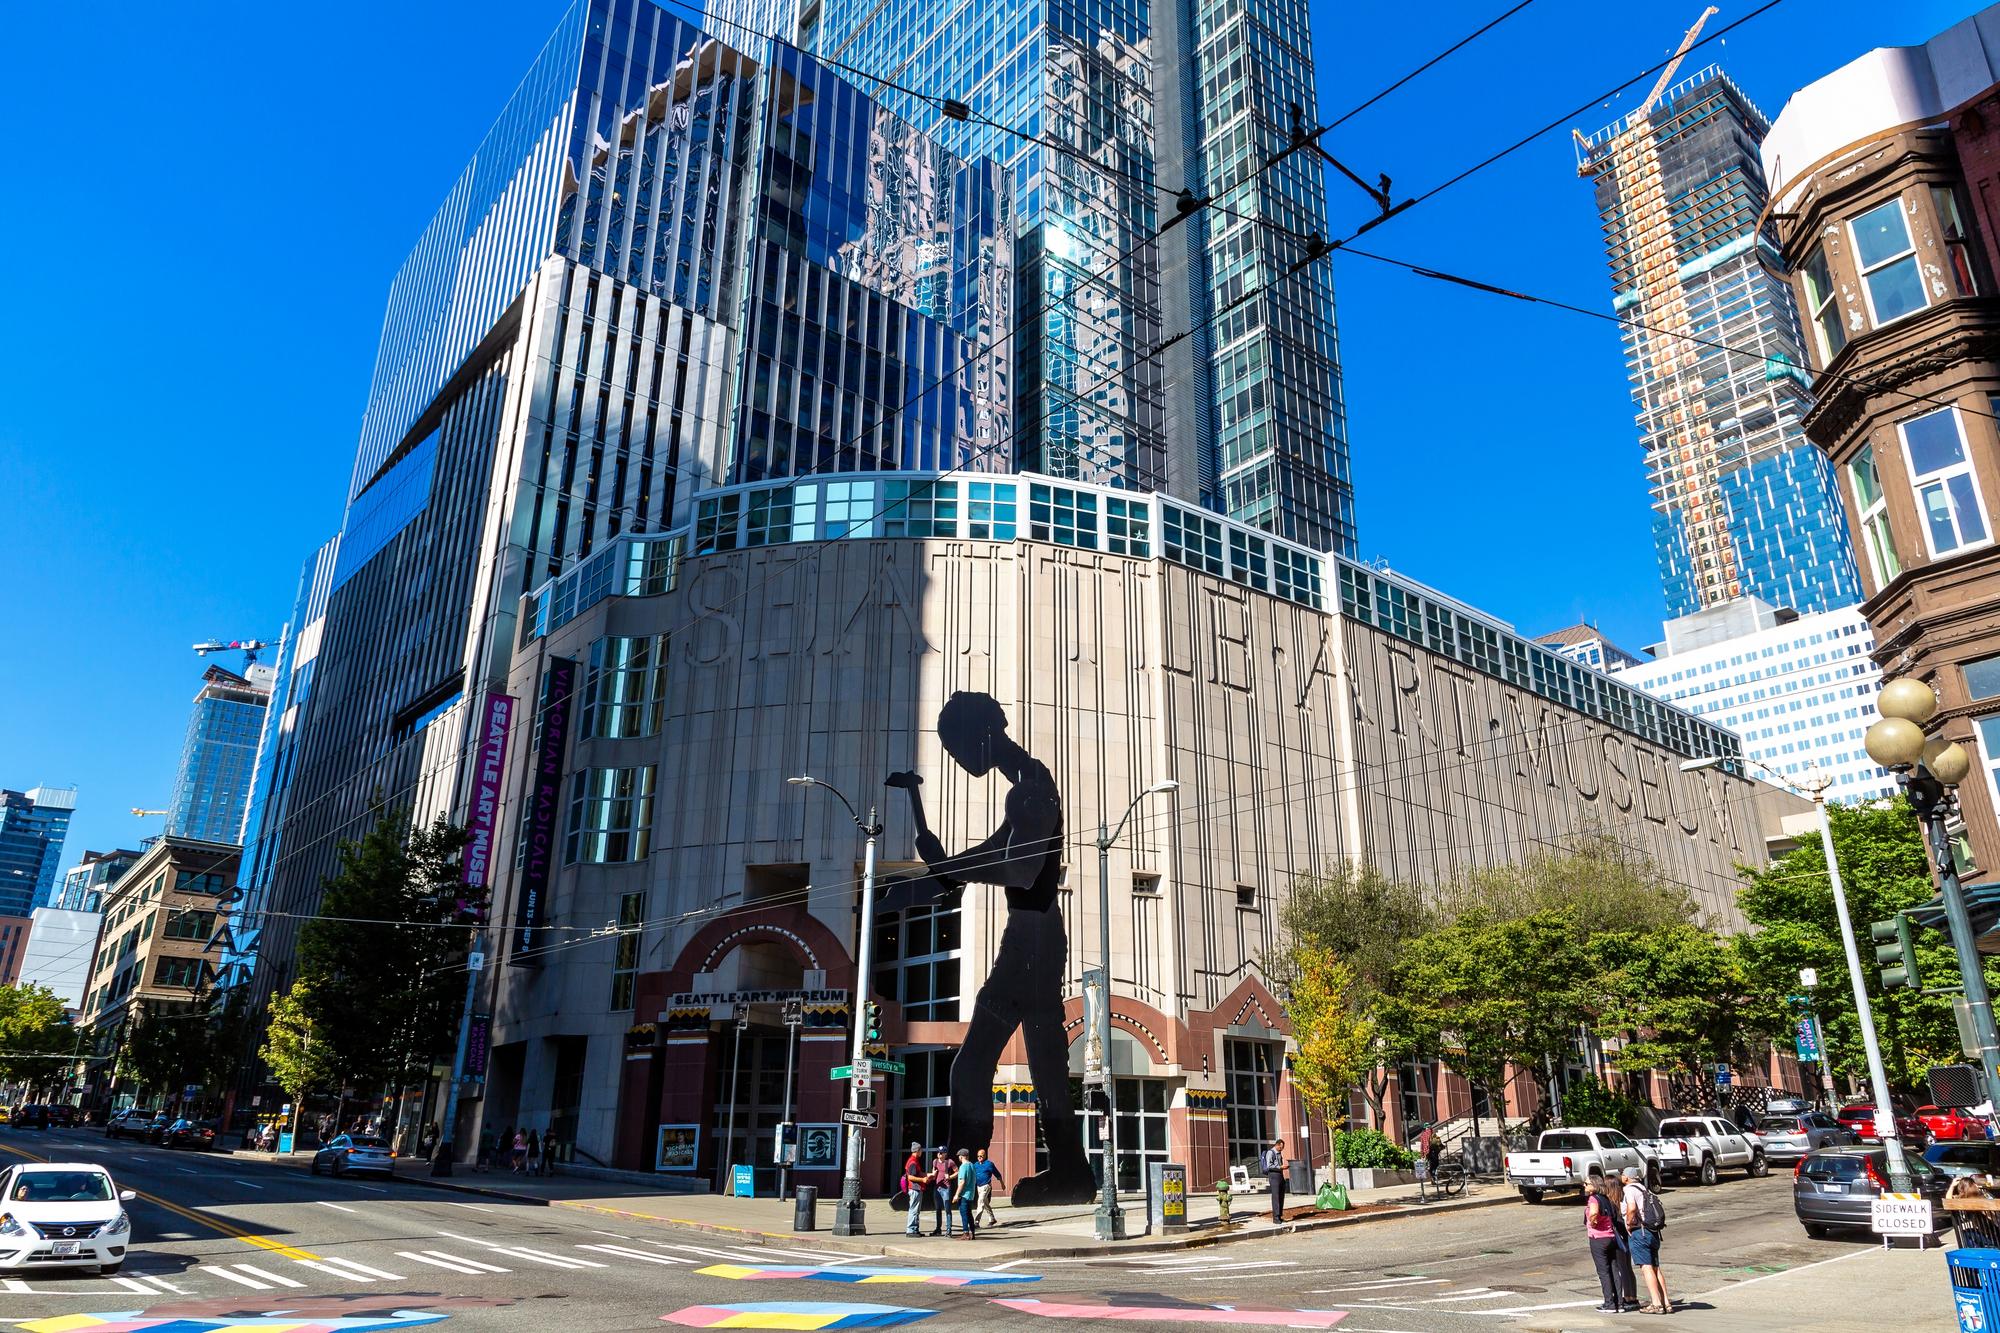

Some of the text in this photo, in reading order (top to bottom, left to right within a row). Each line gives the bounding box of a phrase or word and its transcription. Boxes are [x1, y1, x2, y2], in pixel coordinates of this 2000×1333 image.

[1297, 625, 1476, 760] ART
[1507, 694, 1743, 852] MUSEUM
[463, 699, 508, 915] SEATTLE ART MUSE
[527, 887, 537, 909] JUN
[526, 909, 534, 919] 13
[675, 990, 844, 1005] SEATTLE ART MUSEUM
[1803, 1018, 1816, 1050] TORIAN
[1875, 1203, 1927, 1214] SIDEWALK
[1877, 1218, 1926, 1229] CLOSED
